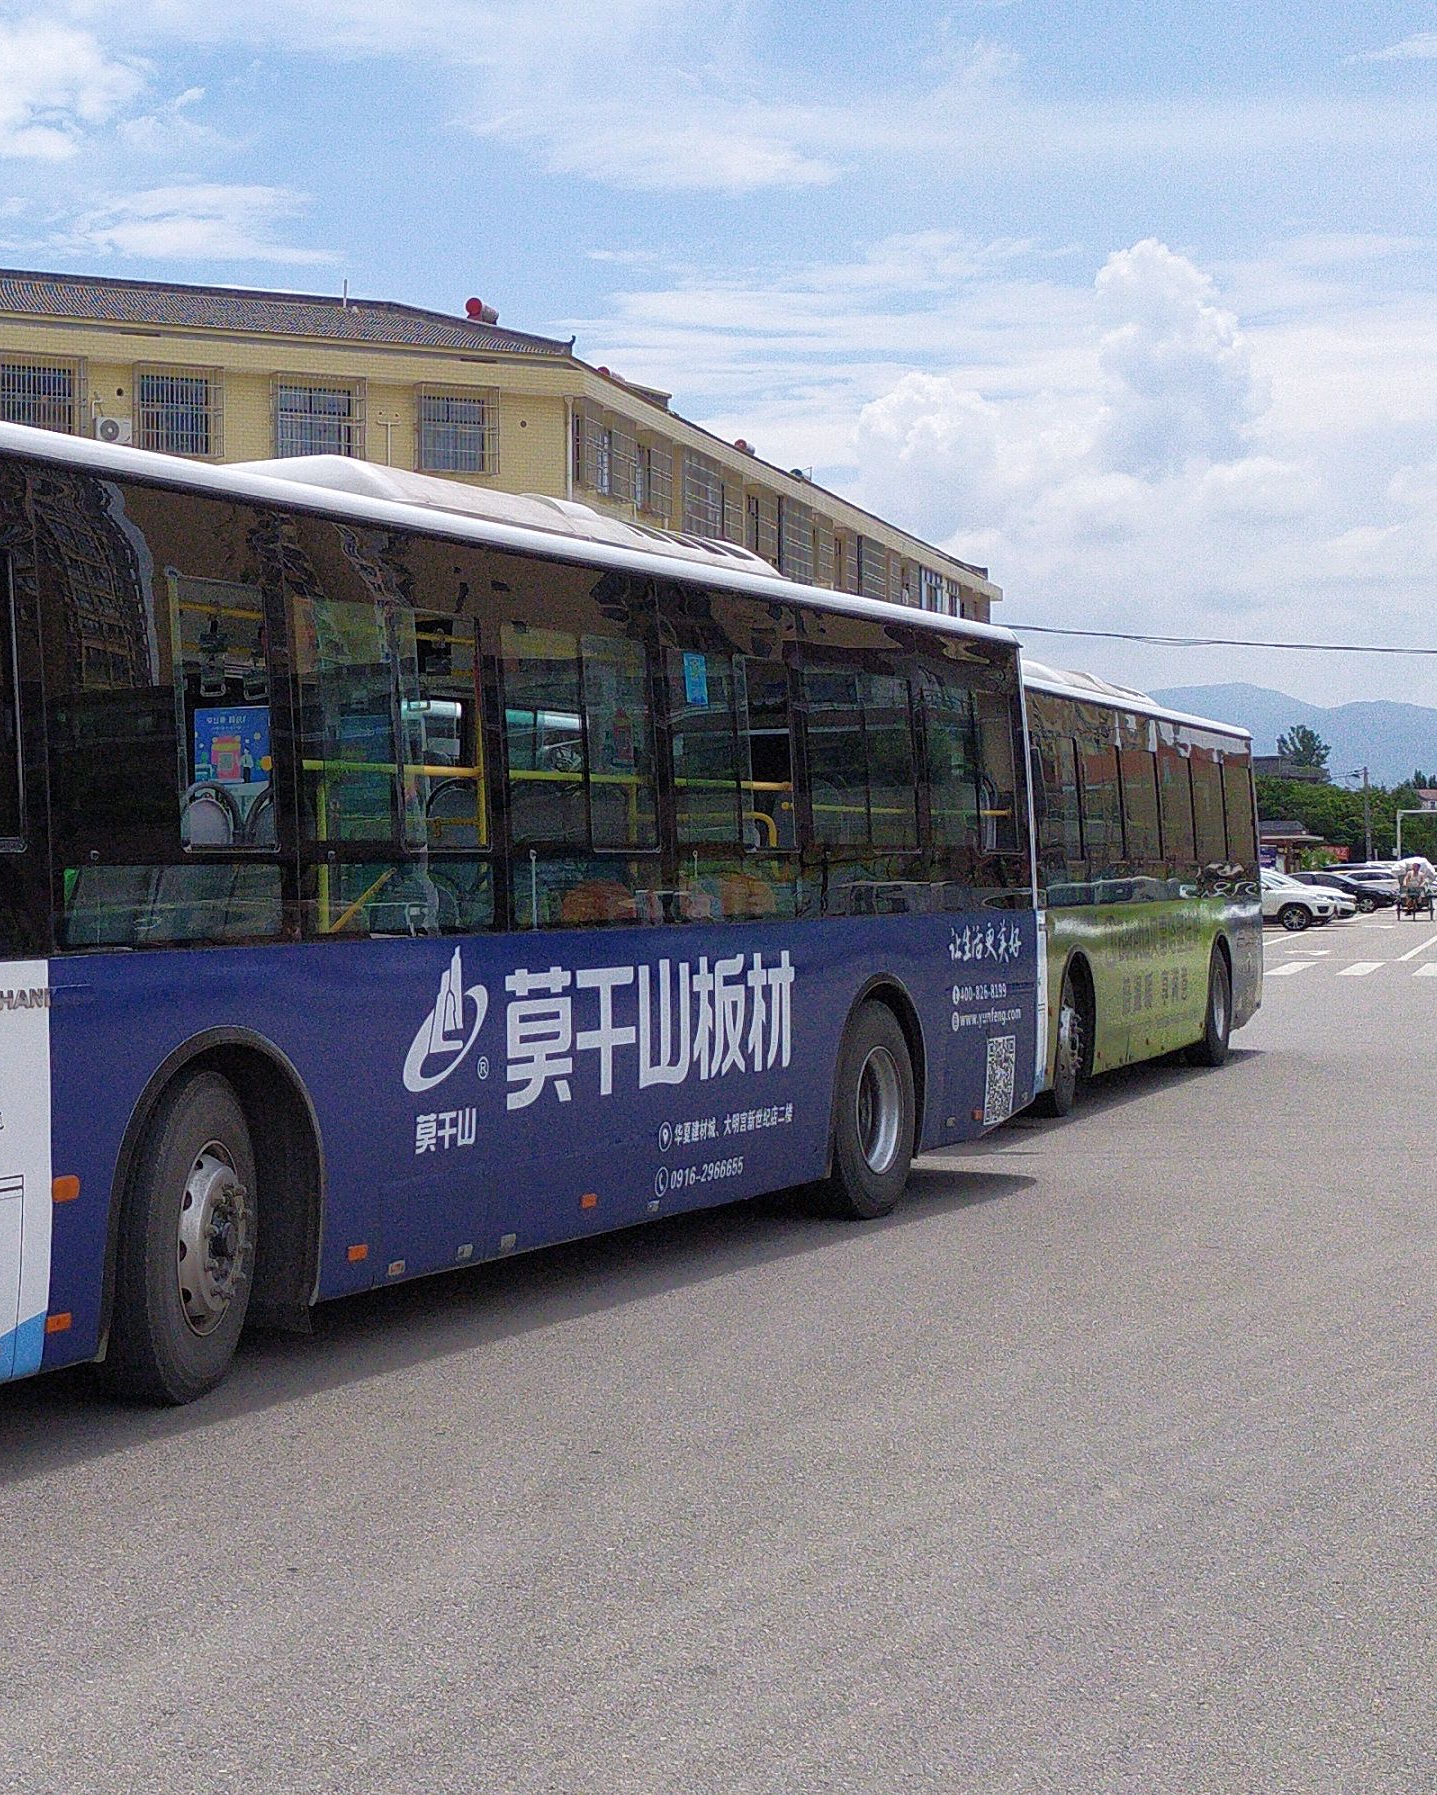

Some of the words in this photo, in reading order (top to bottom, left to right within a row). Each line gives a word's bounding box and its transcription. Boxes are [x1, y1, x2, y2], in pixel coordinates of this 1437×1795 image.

[948, 919, 1022, 964] 让生活更美好
[504, 950, 795, 1110] 莫干山板材
[415, 1107, 477, 1155] 莫干山
[670, 1156, 744, 1190] 0916-2966655
